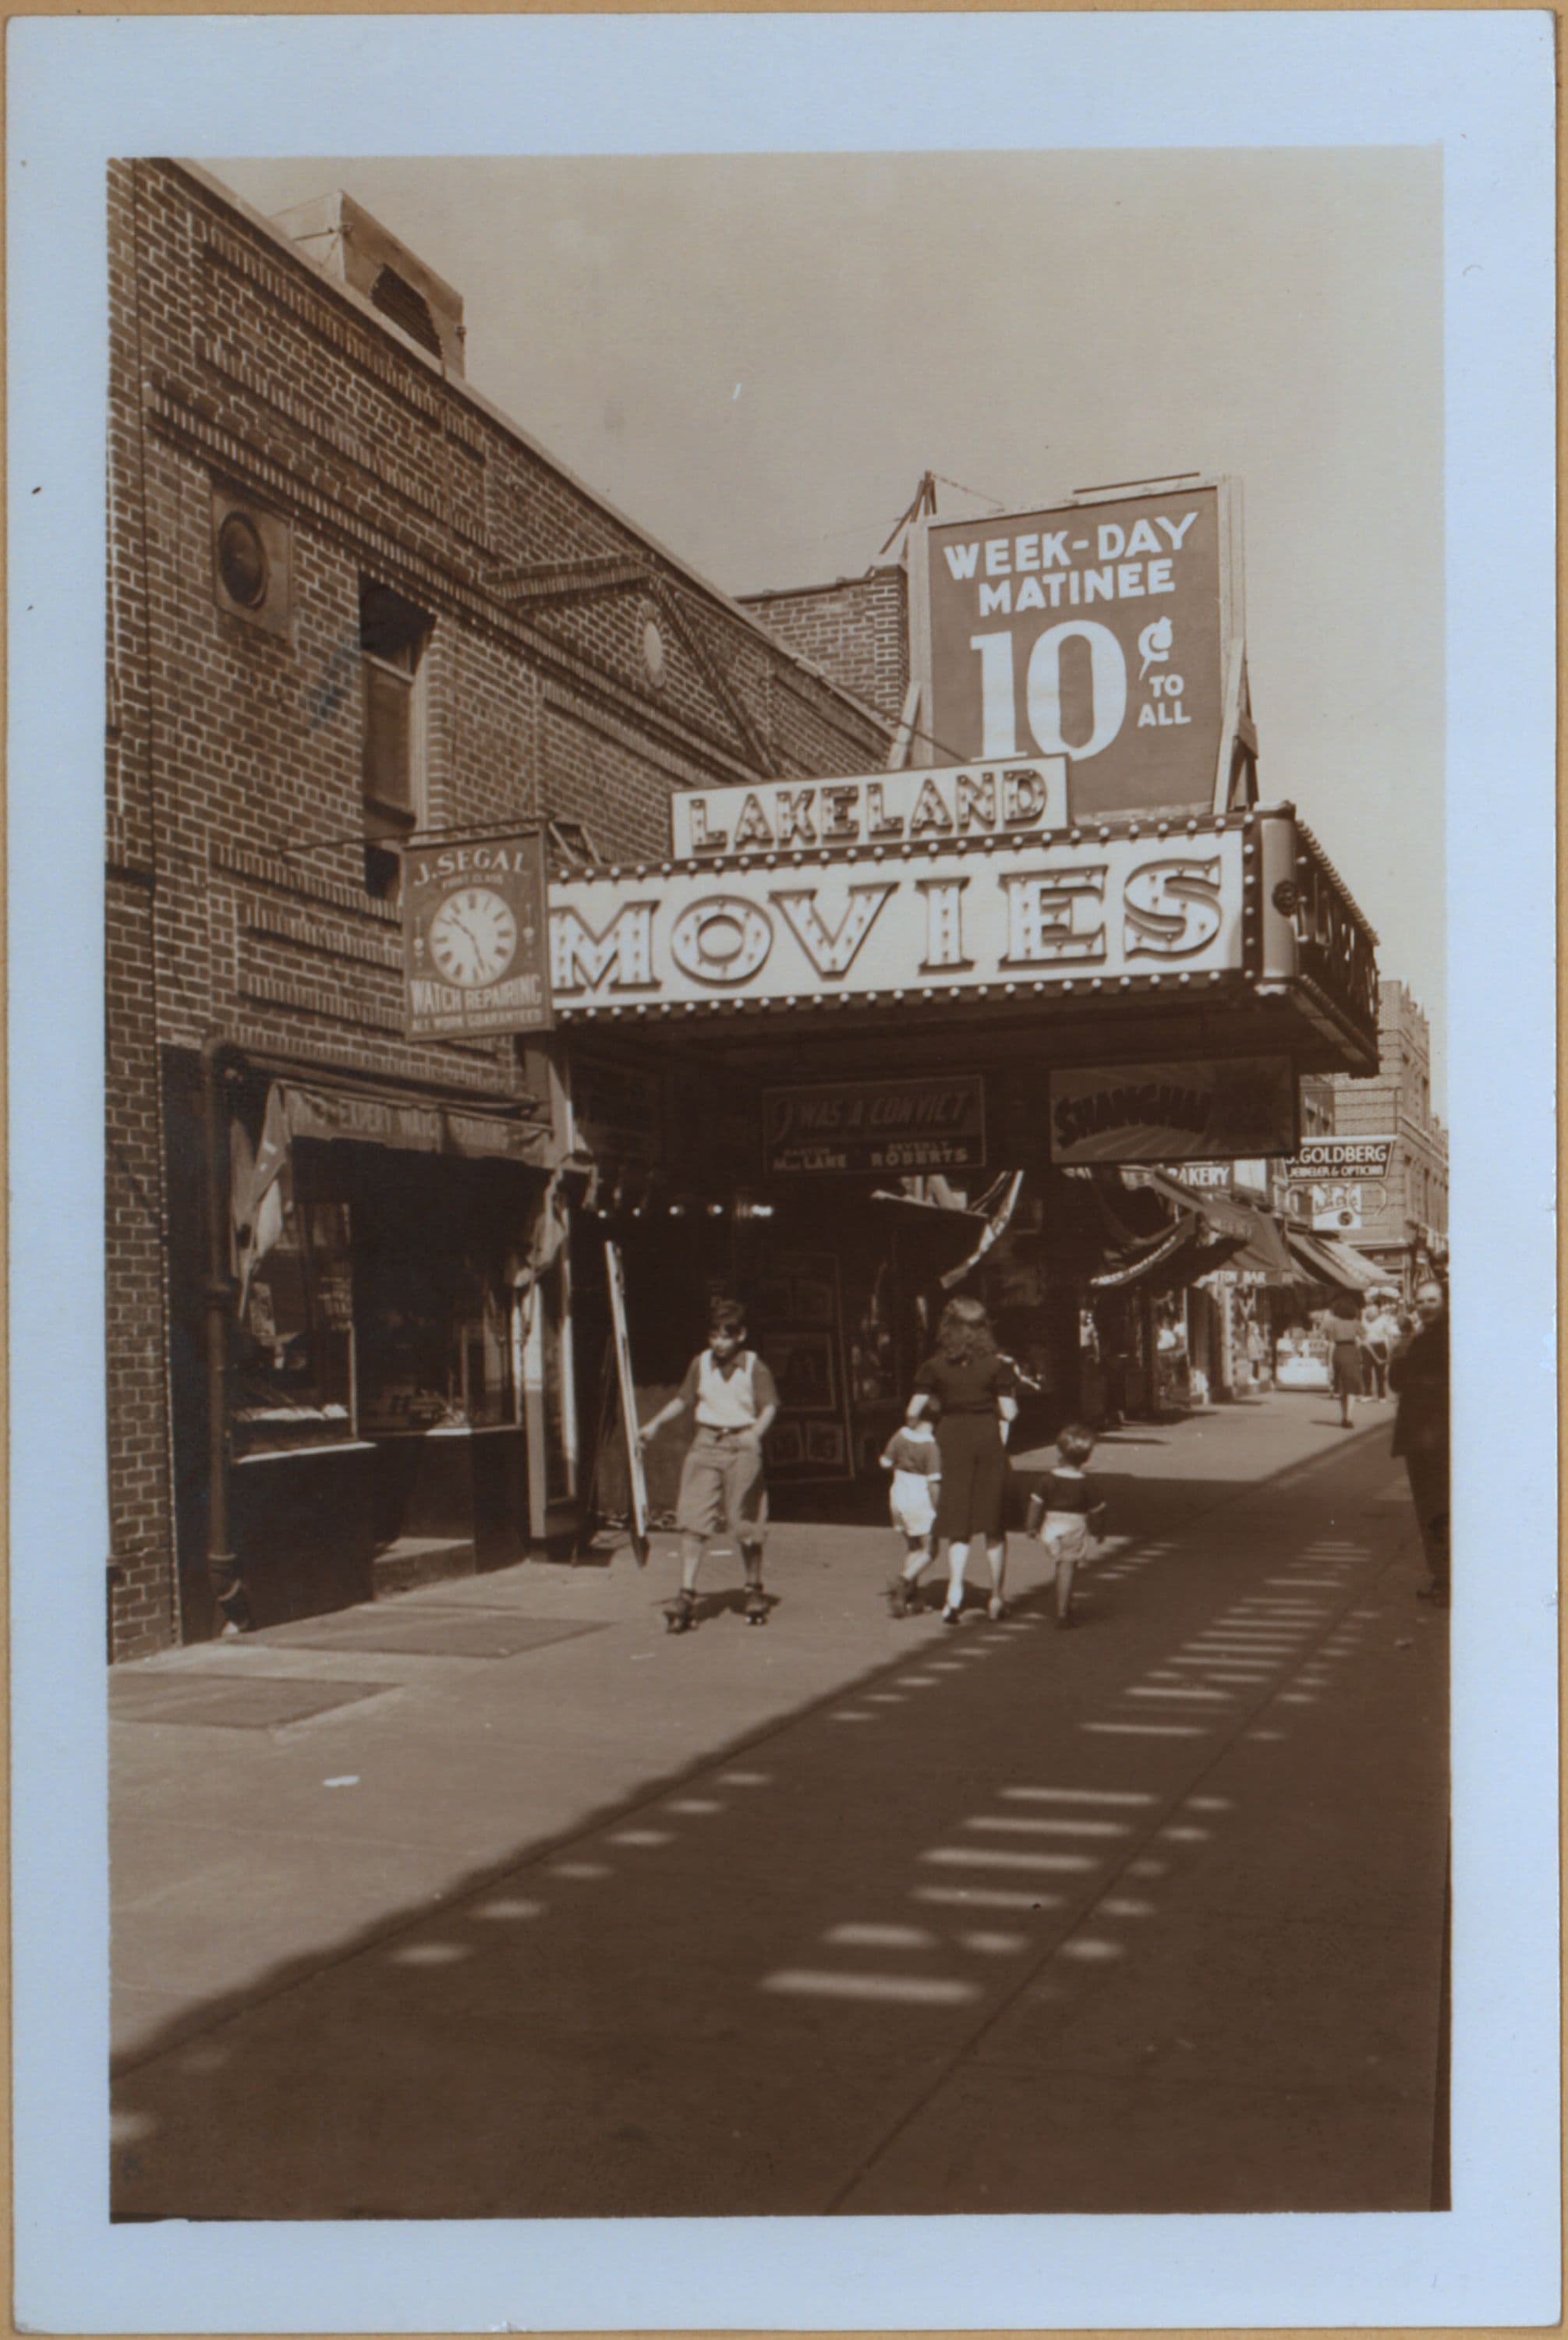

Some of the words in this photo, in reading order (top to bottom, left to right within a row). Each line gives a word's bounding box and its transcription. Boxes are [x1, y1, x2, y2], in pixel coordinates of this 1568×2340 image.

[943, 512, 1199, 580] WEEK-DAY
[979, 558, 1176, 617] MATINEE
[1149, 674, 1184, 697] TO
[1137, 700, 1191, 727] ALL
[689, 767, 1049, 849] LAKELAND
[549, 855, 1223, 993] MOVIES
[410, 979, 462, 1016] WATCH
[465, 973, 543, 1012] REPAIRING
[870, 1147, 969, 1167] ROBERTS
